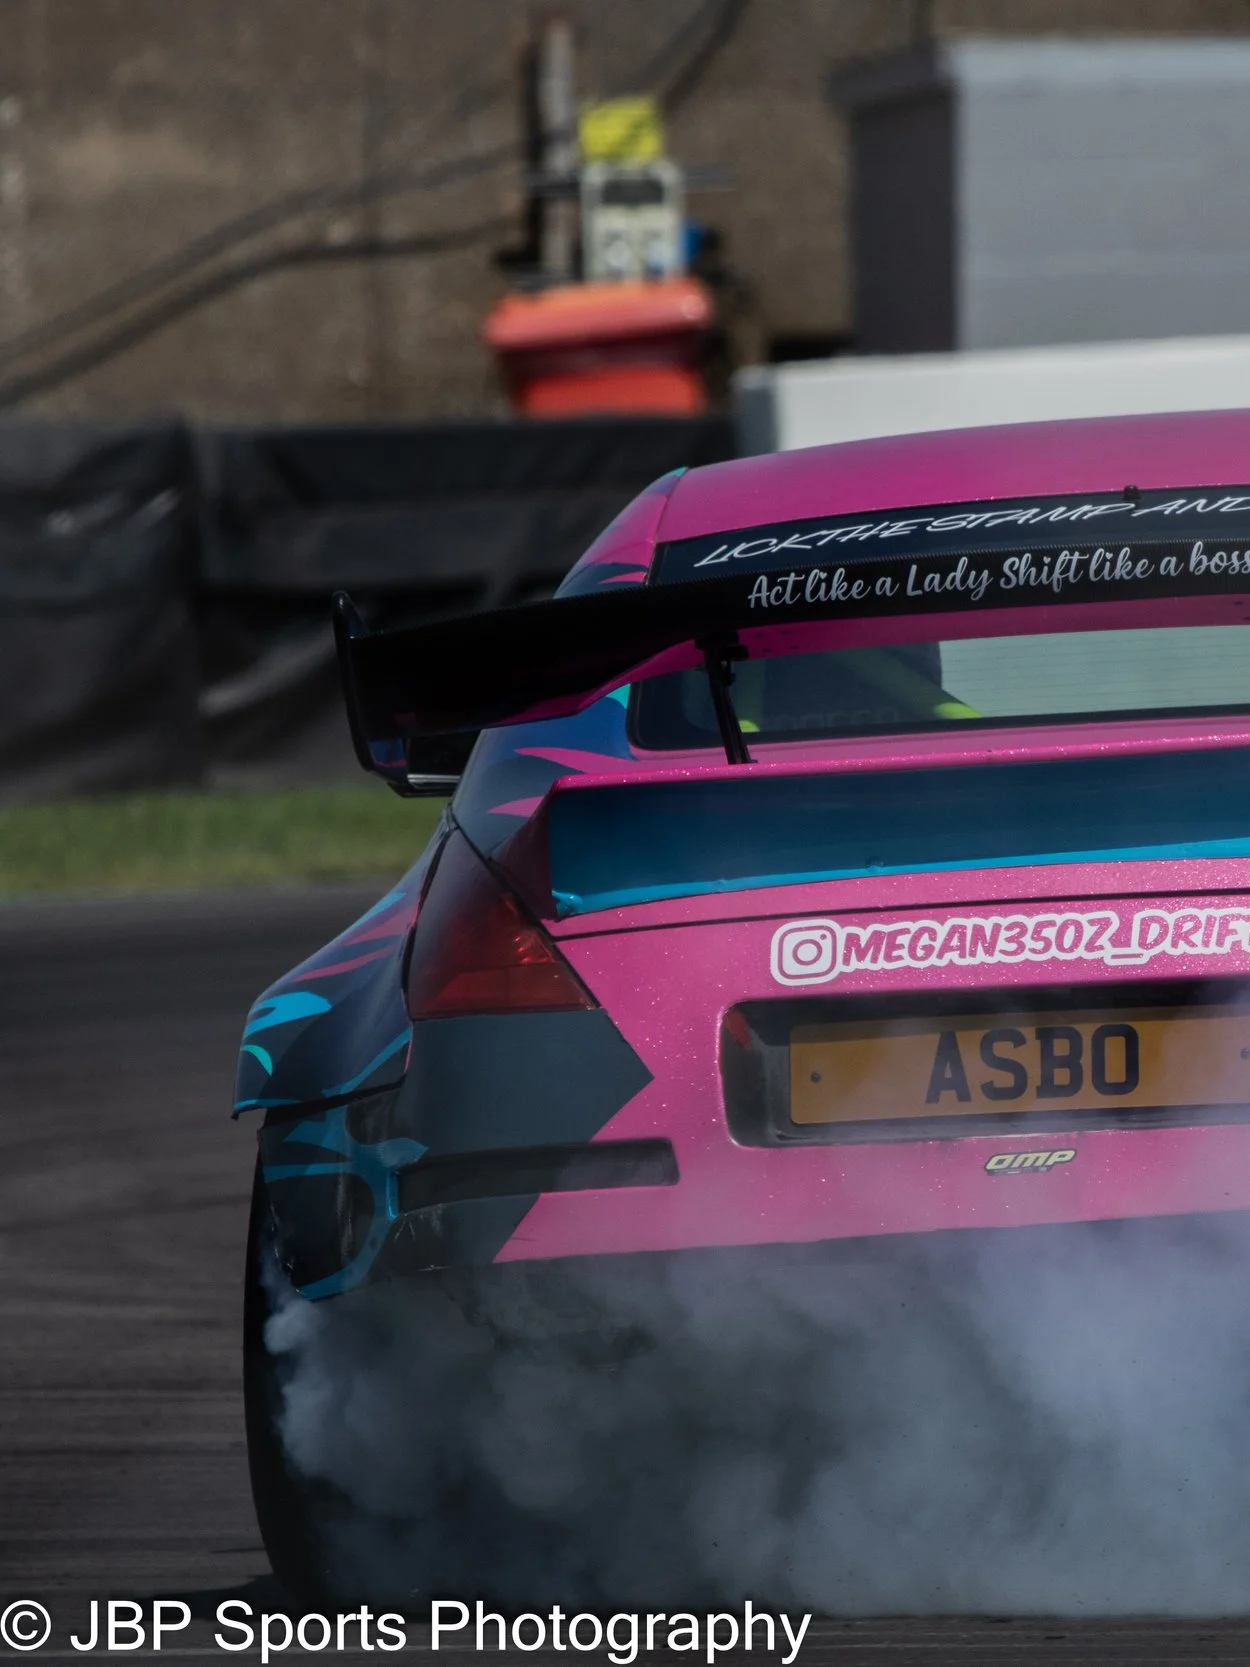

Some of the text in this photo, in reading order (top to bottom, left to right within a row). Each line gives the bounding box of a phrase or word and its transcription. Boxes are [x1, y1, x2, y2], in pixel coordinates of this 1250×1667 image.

[926, 503, 1136, 532] STAMP
[747, 575, 805, 608] Act
[804, 567, 871, 603] like
[875, 576, 899, 598] a
[906, 556, 994, 601] Lady
[1000, 550, 1090, 593] Shift
[1088, 547, 1155, 583] like
[1160, 555, 1185, 577] a
[924, 1023, 1140, 1105] ASBO
